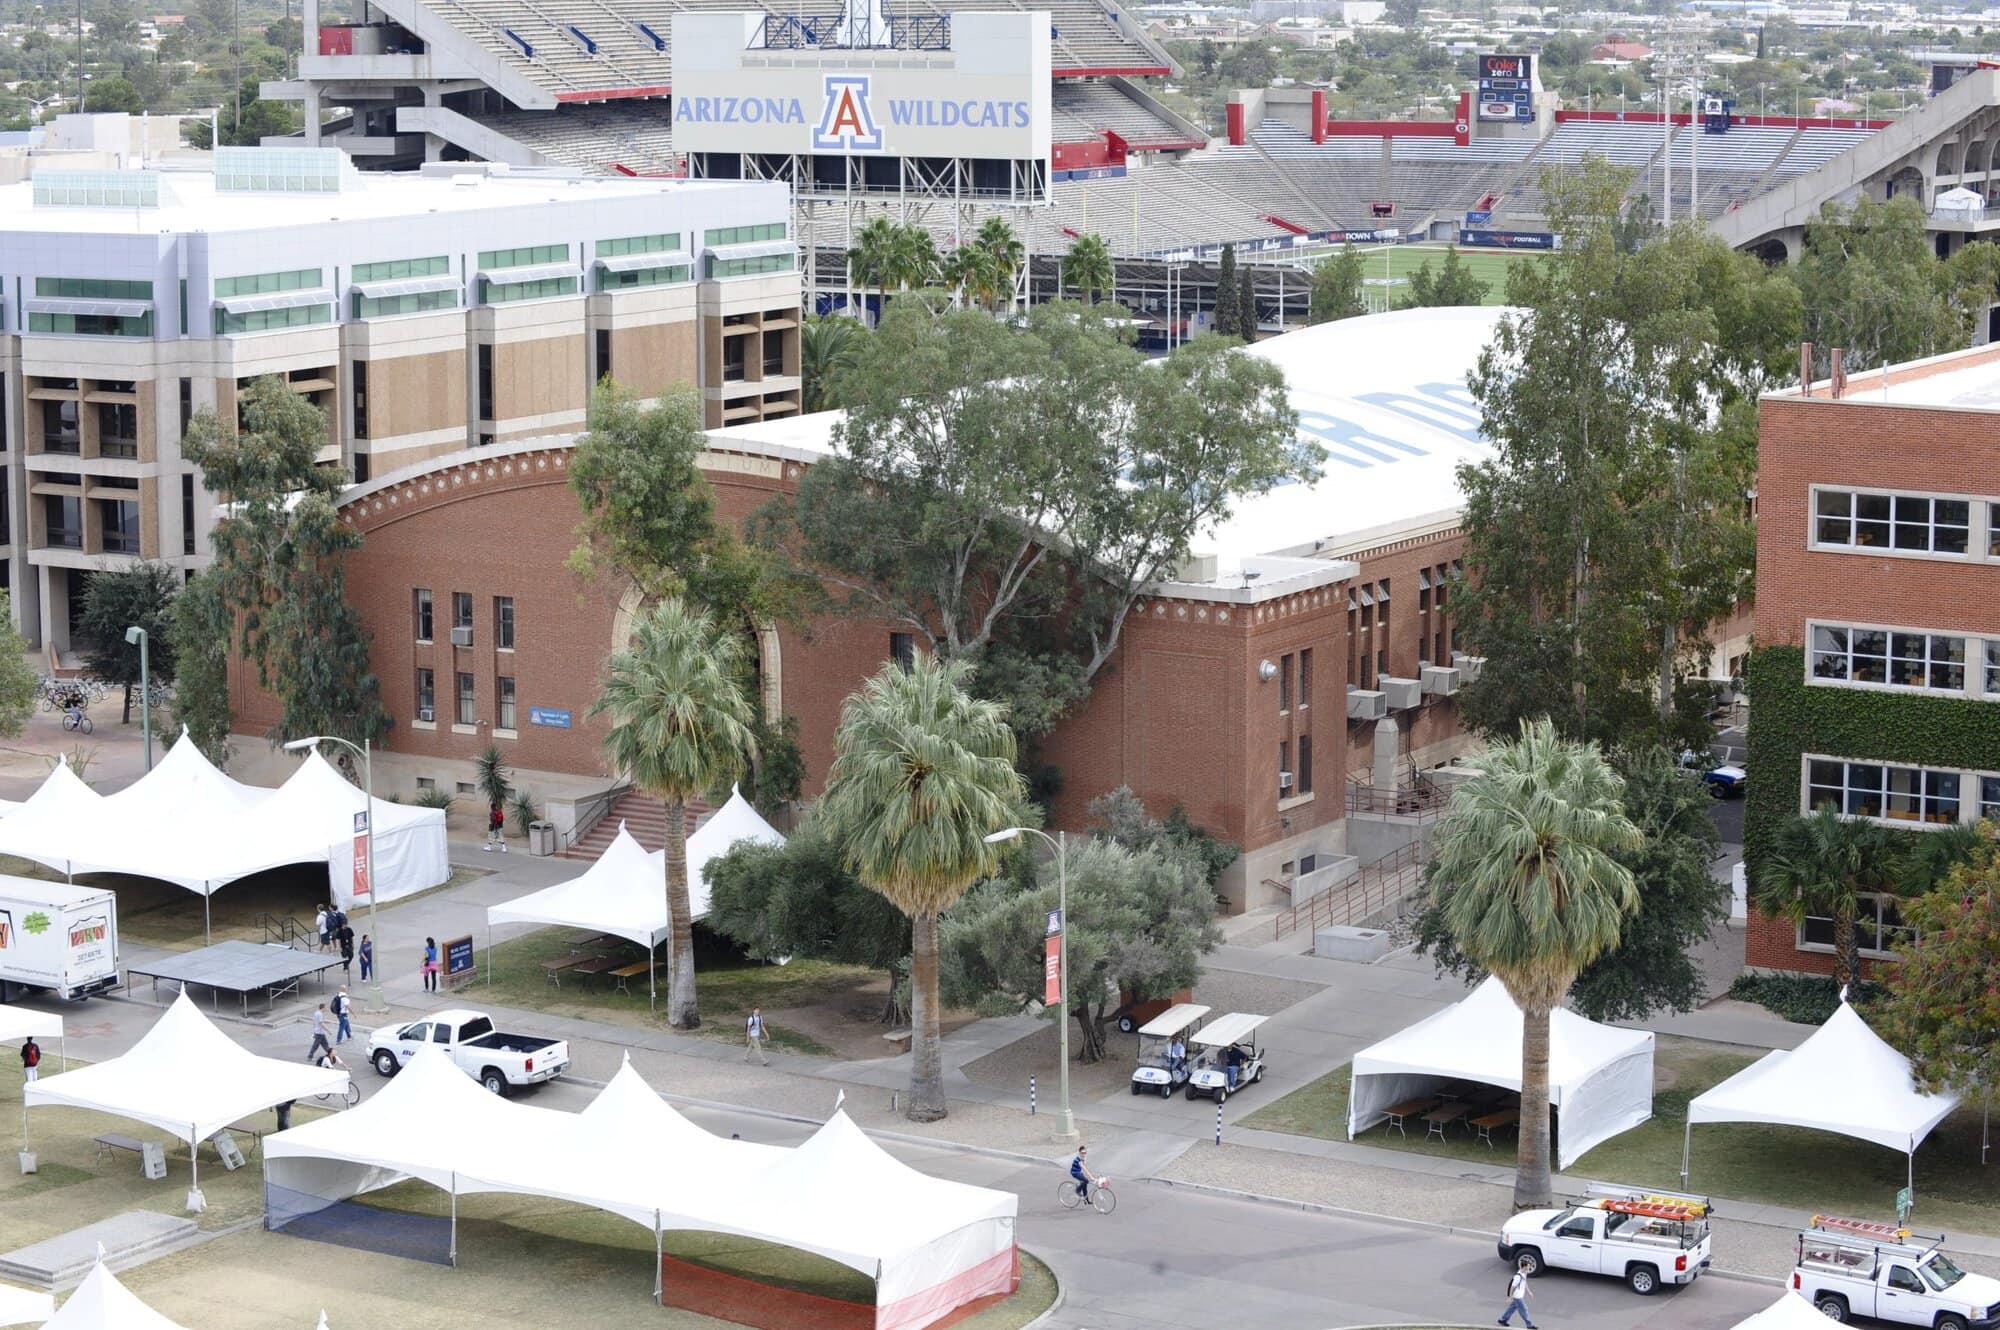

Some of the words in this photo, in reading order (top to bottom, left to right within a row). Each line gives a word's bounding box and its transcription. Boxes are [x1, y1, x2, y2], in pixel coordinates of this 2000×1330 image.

[1487, 57, 1517, 71] Coke
[675, 97, 805, 124] ARIZONA
[812, 76, 885, 150] A
[889, 100, 1030, 128] WILDCATS
[1345, 232, 1371, 240] DOWN
